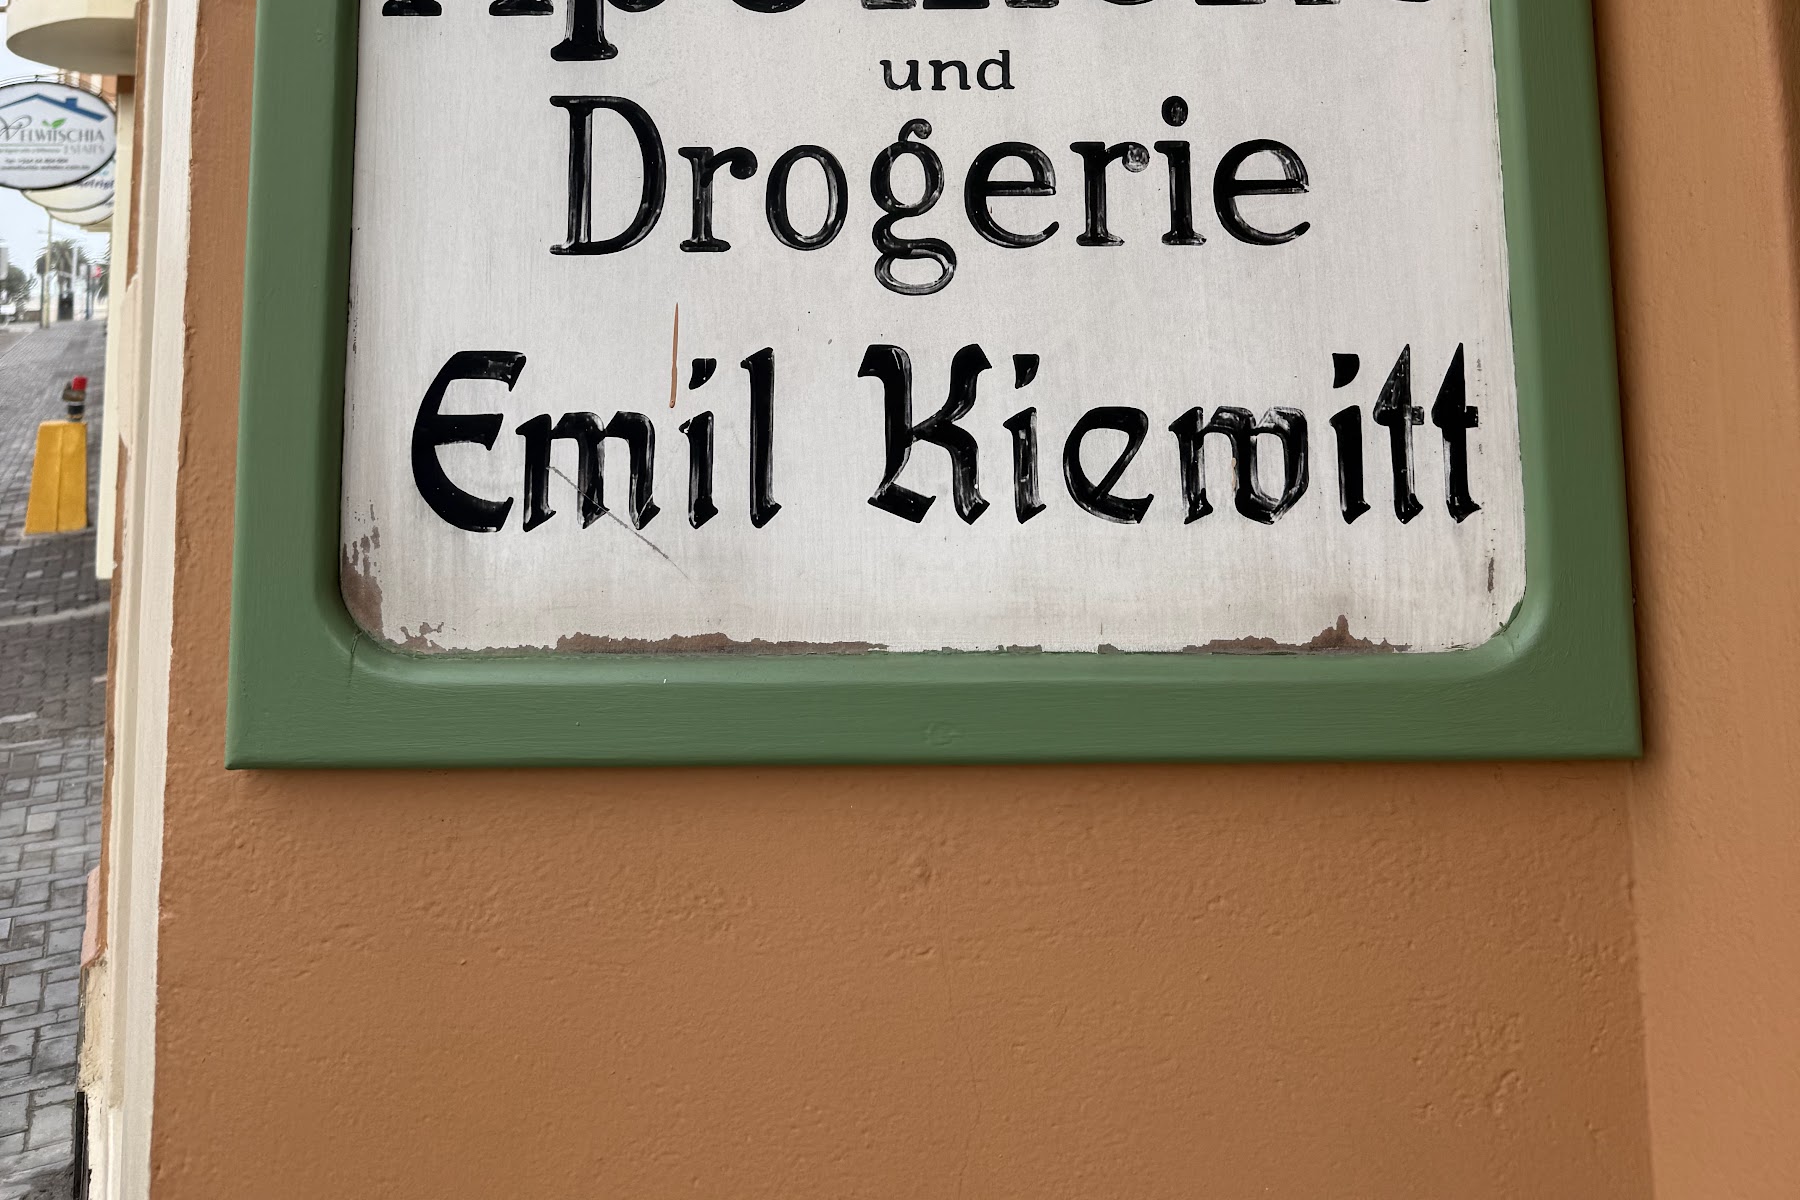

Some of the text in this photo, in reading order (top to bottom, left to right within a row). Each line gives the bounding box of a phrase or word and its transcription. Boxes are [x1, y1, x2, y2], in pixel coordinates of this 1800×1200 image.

[880, 50, 1015, 91] und
[550, 96, 1311, 296] Drogerie
[411, 343, 1482, 533] Emil Kiewitt
